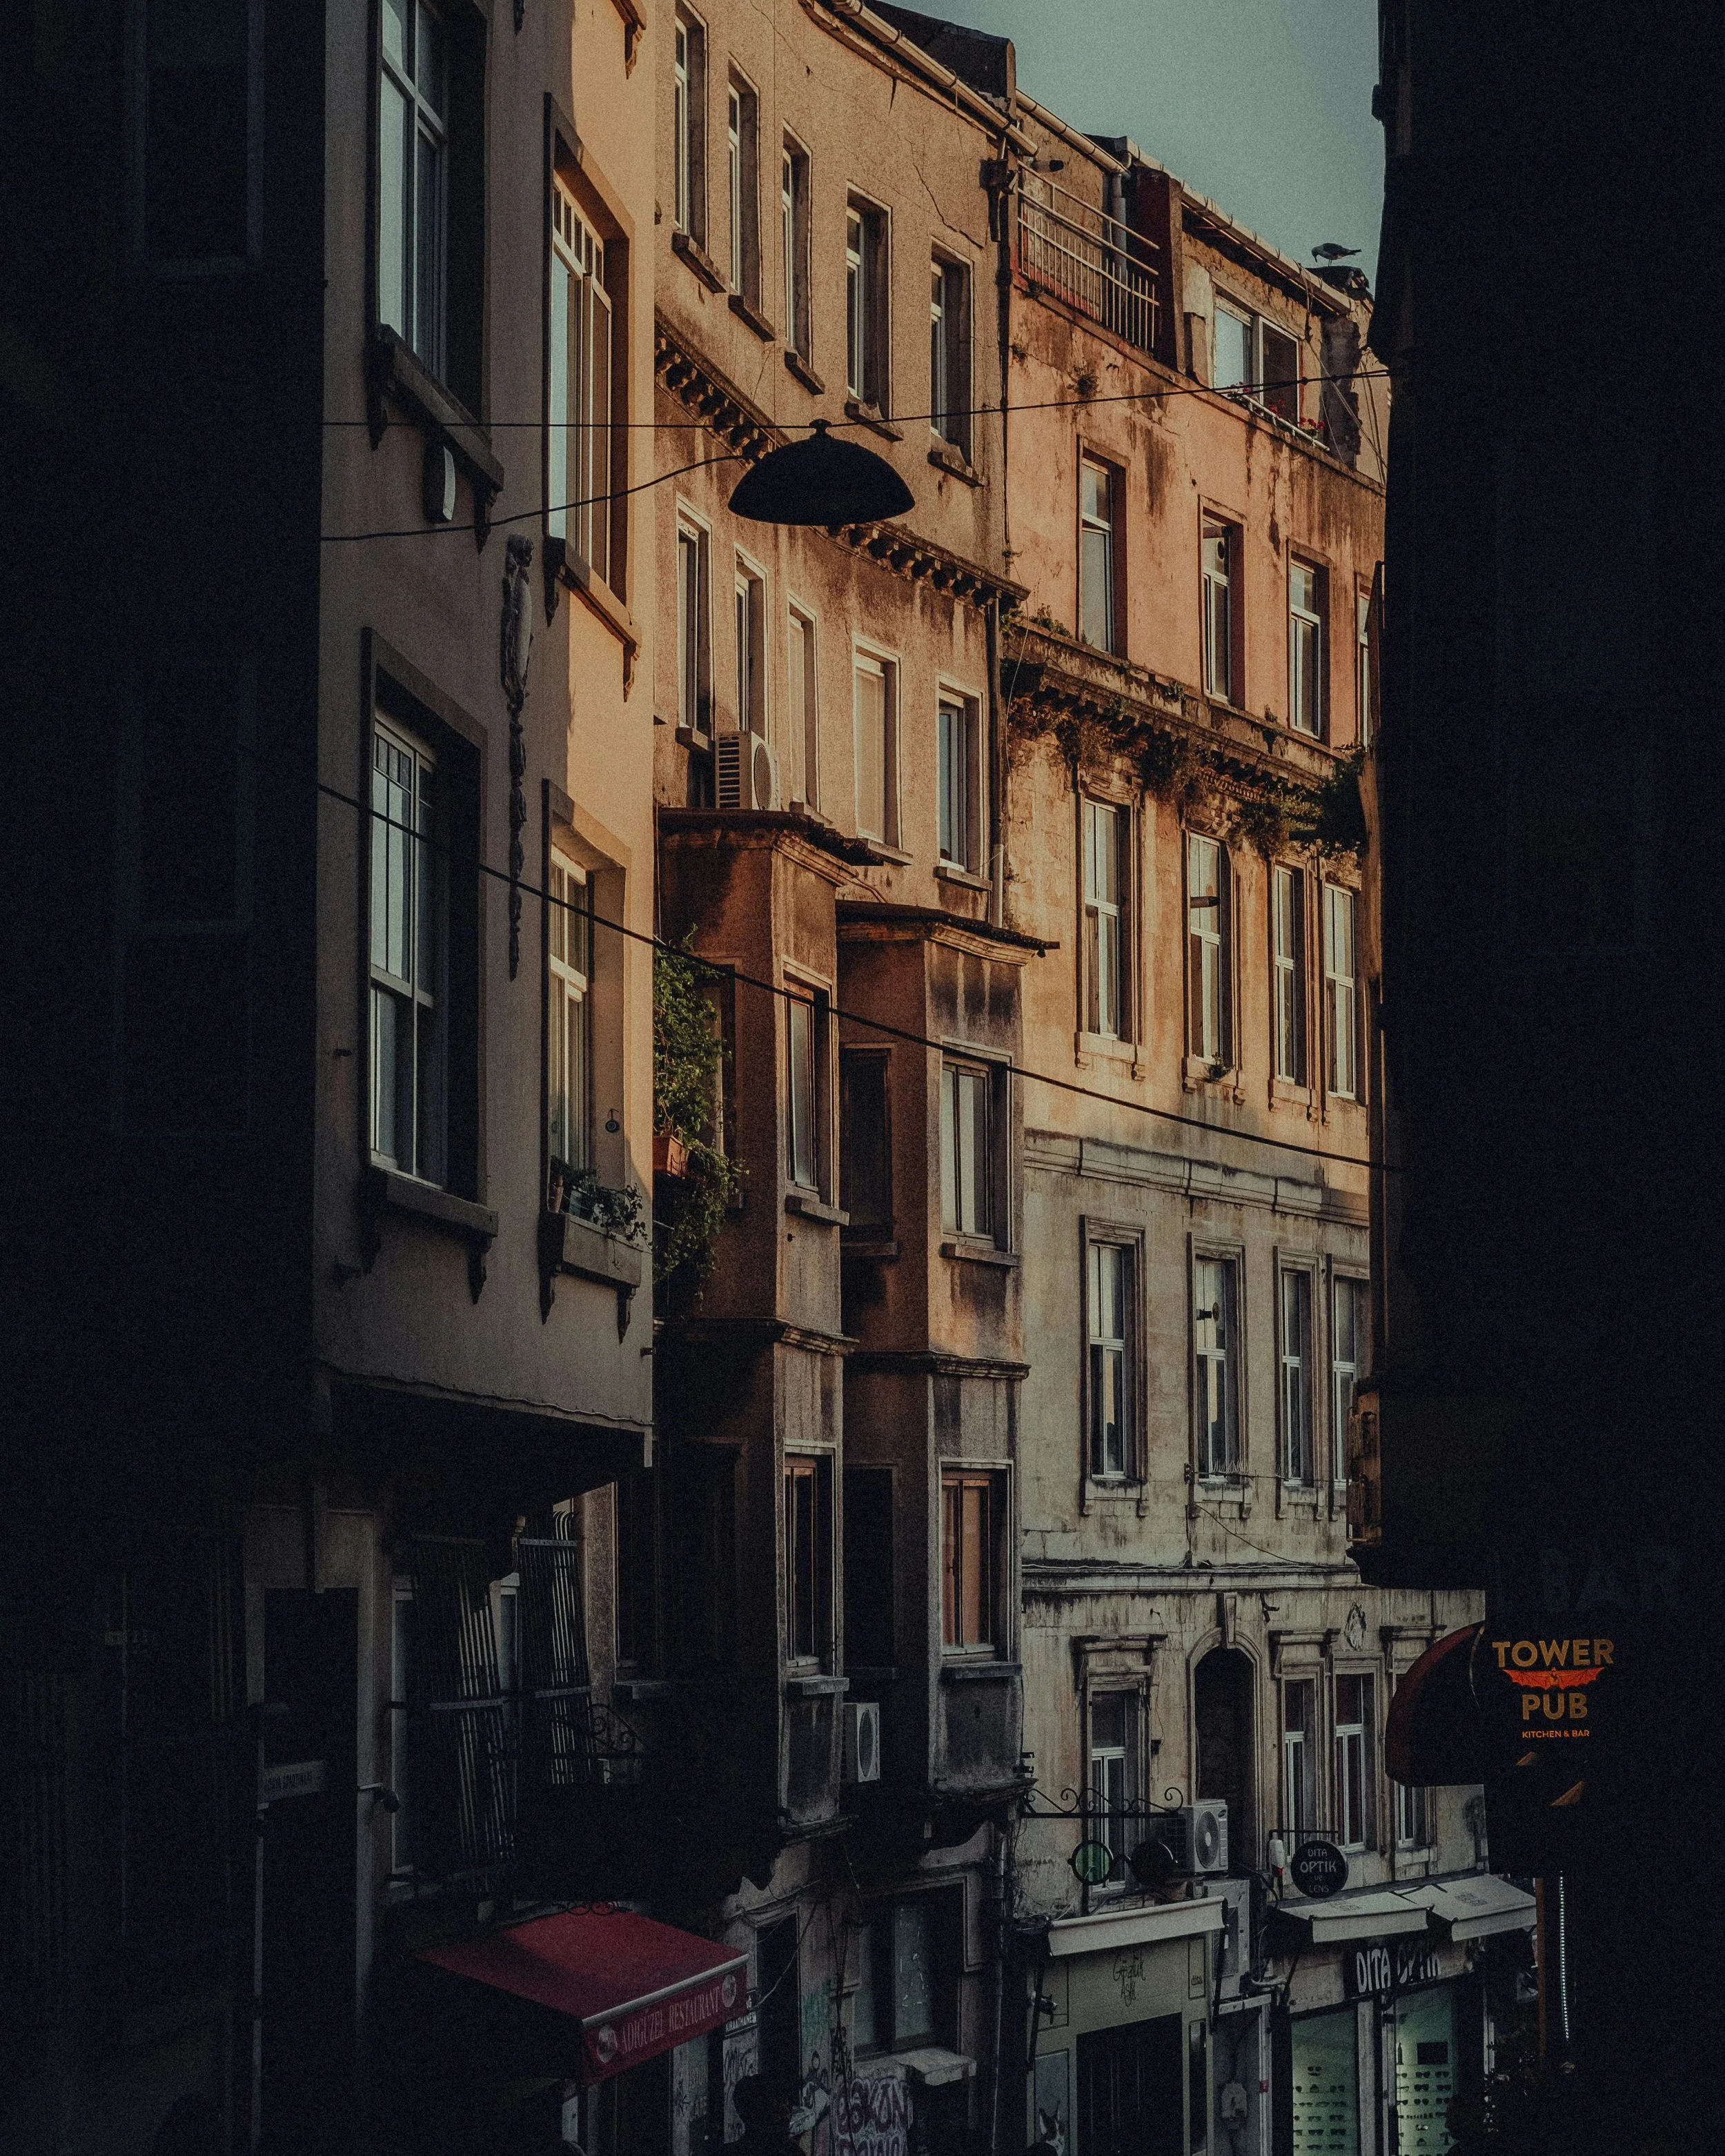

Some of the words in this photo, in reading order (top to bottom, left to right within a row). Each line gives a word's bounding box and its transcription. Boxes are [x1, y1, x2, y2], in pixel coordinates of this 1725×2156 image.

[1492, 1639, 1615, 1668] TOWER
[1521, 1692, 1588, 1720] PUB
[1521, 1730, 1561, 1739] KITCHEN
[1572, 1729, 1590, 1737] BAR
[1308, 1848, 1328, 1857] DITA
[1309, 1884, 1330, 1893] LENS
[1356, 1947, 1391, 1993] DITA
[622, 2007, 665, 2054] ADIGÜZEL
[669, 1986, 720, 2033] RESTAURANT
